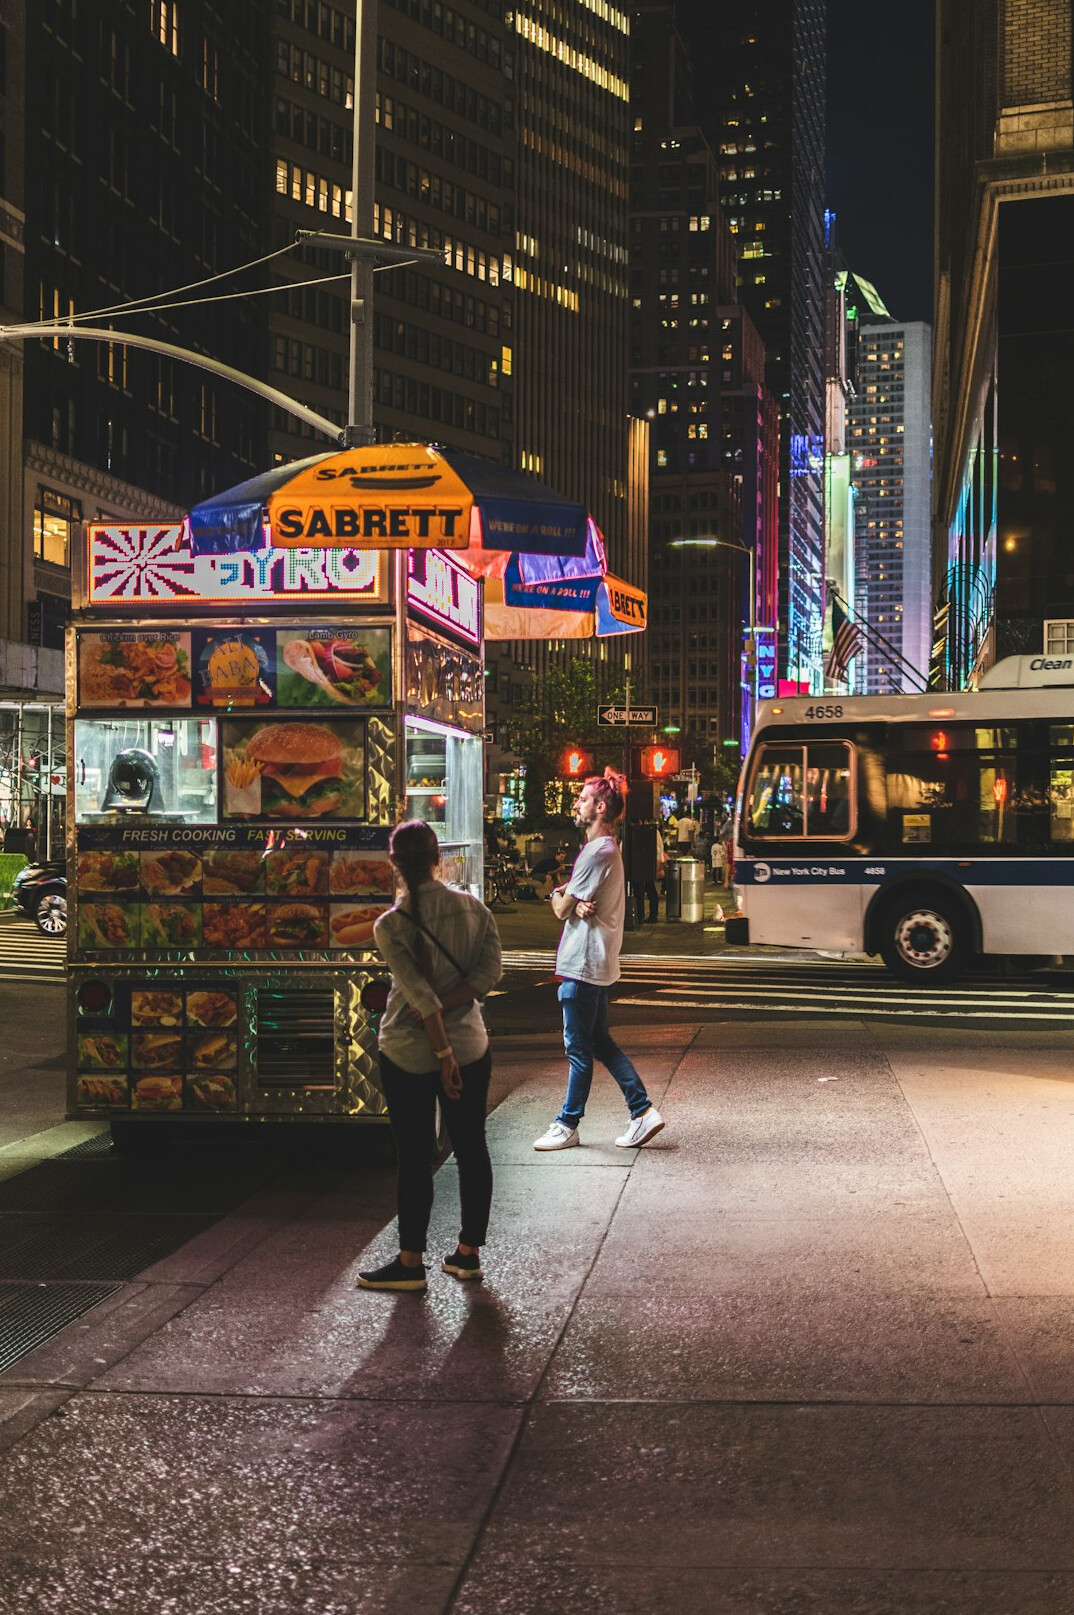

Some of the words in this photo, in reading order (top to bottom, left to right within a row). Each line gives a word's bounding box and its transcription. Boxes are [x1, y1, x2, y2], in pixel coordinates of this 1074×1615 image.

[316, 463, 437, 481] SABRETT
[276, 505, 462, 539] SABRETT
[541, 525, 562, 537] ROLL
[536, 585, 549, 595] ON
[557, 587, 577, 598] ROLL
[579, 589, 590, 599] !!!
[160, 631, 180, 641] Rice
[310, 630, 333, 640] Lamb
[336, 630, 358, 641] Gyro
[1030, 658, 1072, 671] Clean
[607, 711, 624, 720] ONE
[631, 712, 650, 720] WAY
[805, 706, 843, 719] 4658
[123, 830, 167, 842] FRESH
[171, 830, 236, 842] COOKING
[247, 829, 282, 841] FAST
[285, 829, 347, 841] SERVING
[772, 867, 791, 876] New
[791, 867, 810, 876] York
[811, 867, 828, 877] City
[829, 867, 846, 876] Bus
